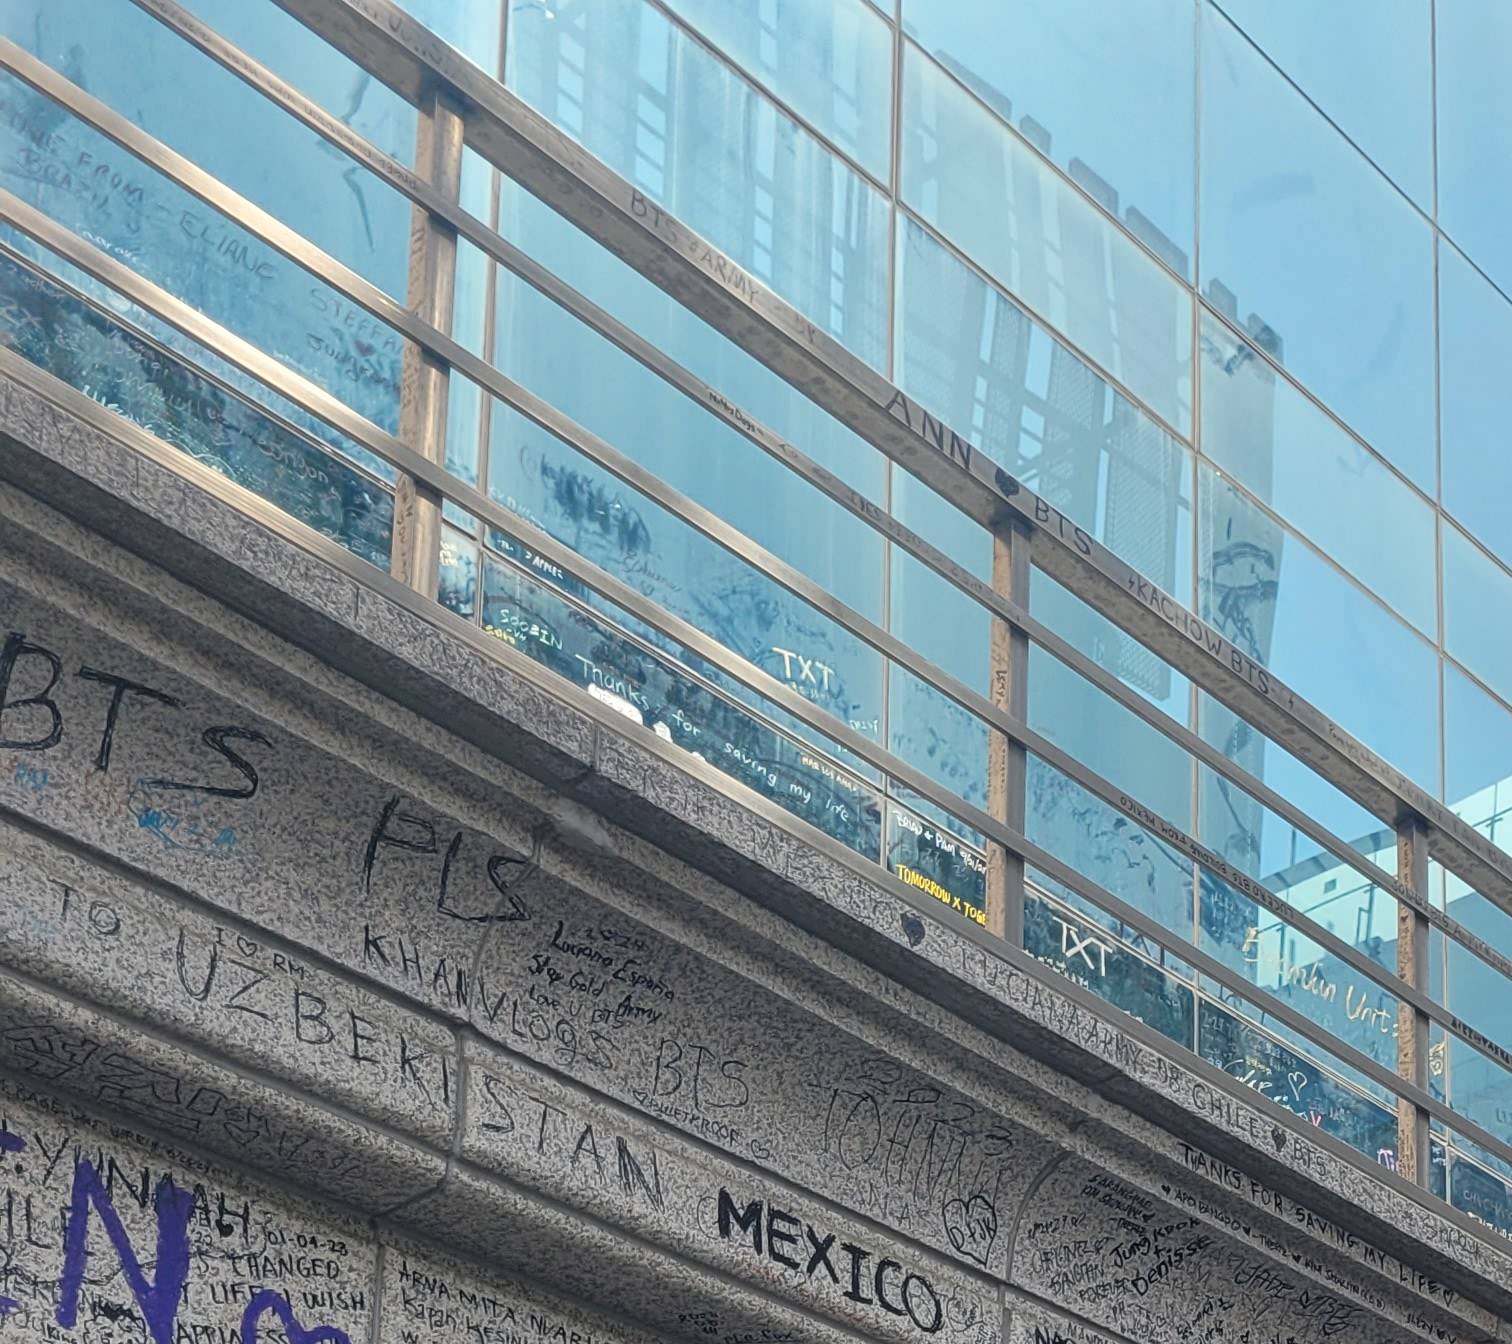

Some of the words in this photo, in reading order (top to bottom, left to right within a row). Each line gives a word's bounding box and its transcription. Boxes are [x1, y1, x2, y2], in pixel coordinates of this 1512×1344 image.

[884, 390, 971, 470] ANN
[1036, 497, 1093, 556] BTS
[772, 646, 835, 690] TXT
[0, 630, 273, 801] BTS
[575, 654, 650, 710] Thanks
[672, 710, 702, 736] for
[725, 742, 777, 787] saving
[789, 782, 812, 805] my
[1056, 917, 1113, 978] TXT
[653, 1037, 749, 1109] BTS
[1250, 1182, 1284, 1215] FOR
[1295, 1206, 1360, 1252] SAVING
[232, 1256, 340, 1280] CHANGED
[717, 1186, 944, 1336] MEXICO
[301, 1292, 366, 1311] WISH
